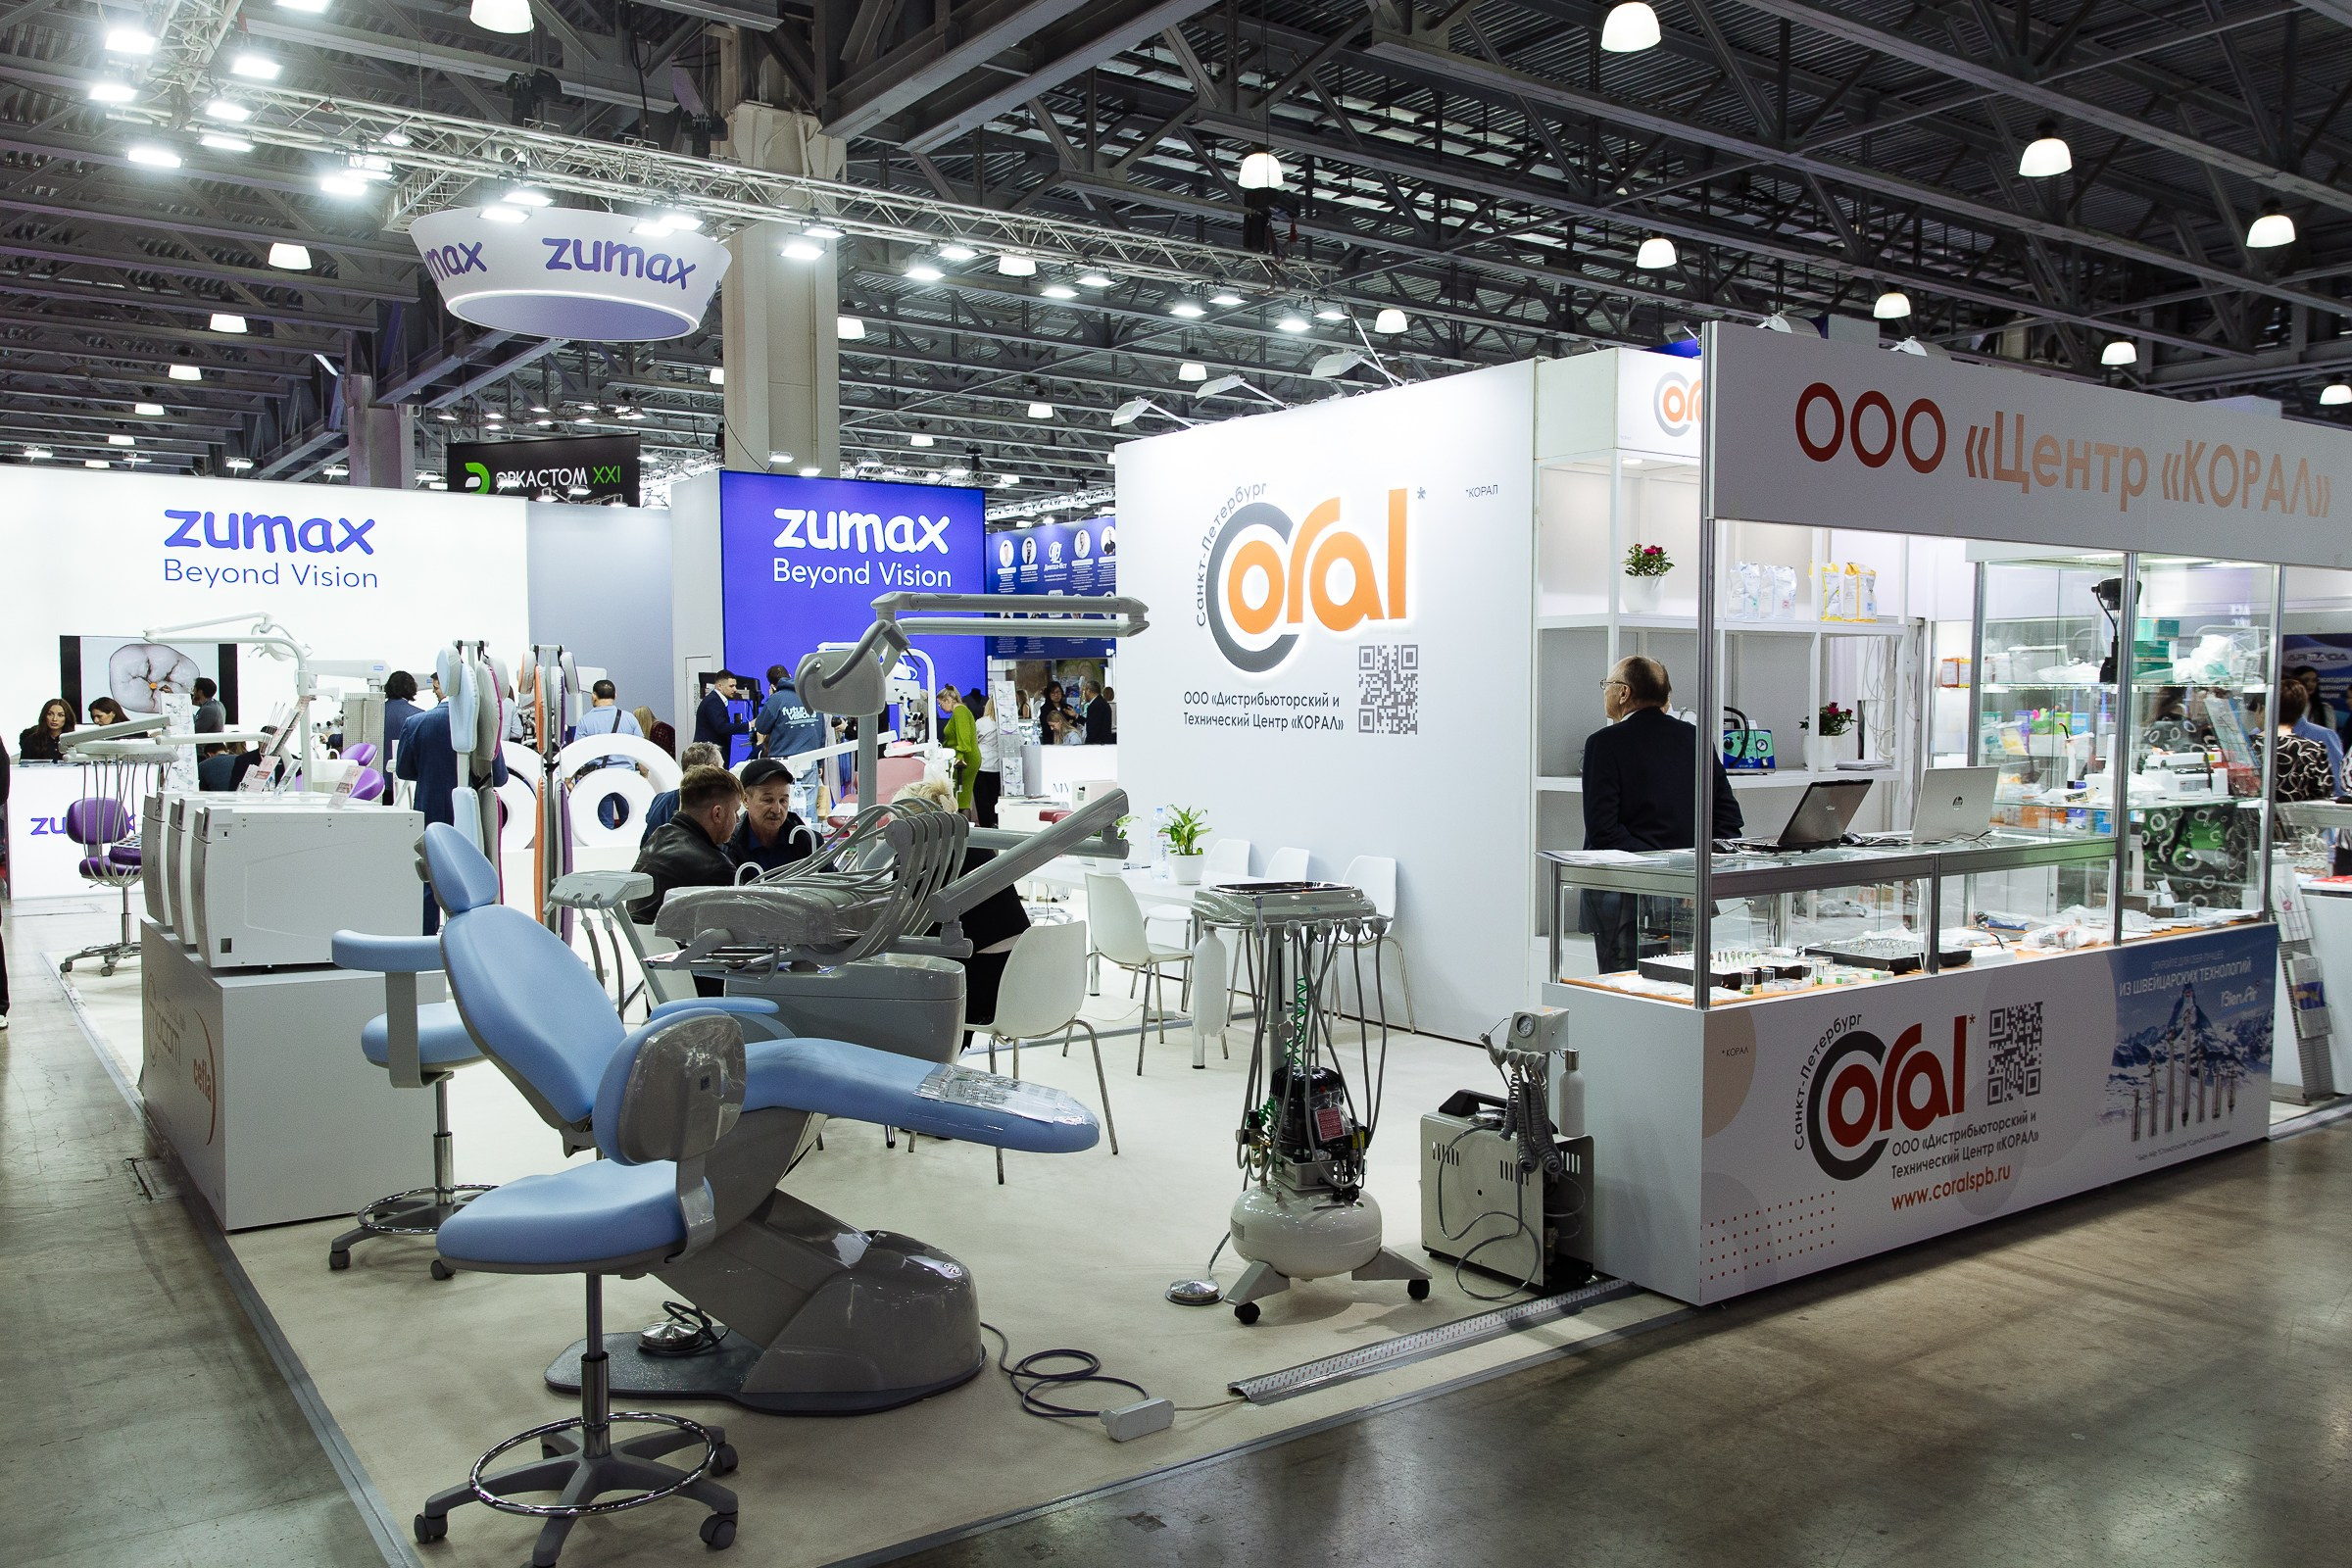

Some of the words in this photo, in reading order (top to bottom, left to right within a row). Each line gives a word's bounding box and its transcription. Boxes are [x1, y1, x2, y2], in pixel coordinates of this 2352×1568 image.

[423, 241, 487, 285] max
[542, 237, 696, 290] zumax
[1795, 382, 1946, 473] ООО
[1964, 411, 2149, 512] «Центр
[2161, 439, 2330, 518] «КОРАЛ»
[593, 466, 620, 485] XXI
[165, 510, 375, 555] zumax
[773, 508, 951, 554] zumax
[165, 559, 279, 588] Beyond
[291, 564, 377, 588] Vision
[773, 558, 870, 588] Beyond
[878, 562, 952, 588] Vision
[1197, 482, 1267, 627] Санкт-Петербург
[1205, 488, 1407, 672] Coral
[1184, 691, 1208, 705] ООО
[1211, 691, 1329, 710] «Дистрибьюторский
[1333, 696, 1340, 708] и
[1184, 712, 1250, 727] Технический
[1252, 714, 1289, 731] Центр
[1292, 714, 1344, 731] «КОРАЛ»
[2119, 982, 2132, 997] ИЗ
[2132, 970, 2199, 995] ШВЕЙЦАРСКИХ
[2199, 956, 2252, 982] ТЕХНОЛОГИЙ
[1794, 1014, 1862, 1151] Санкт-Петербург
[1806, 1014, 1968, 1181] Coral
[1891, 1149, 1959, 1179] Технический
[1962, 1143, 1993, 1161] Центр
[1996, 1130, 2039, 1152] «КОРАЛ»
[1892, 1138, 1920, 1156] ООО
[1923, 1110, 2028, 1151] «Дистрибьюторский
[2031, 1111, 2036, 1122] и
[1891, 1165, 2011, 1210] www.coralspb.ru
